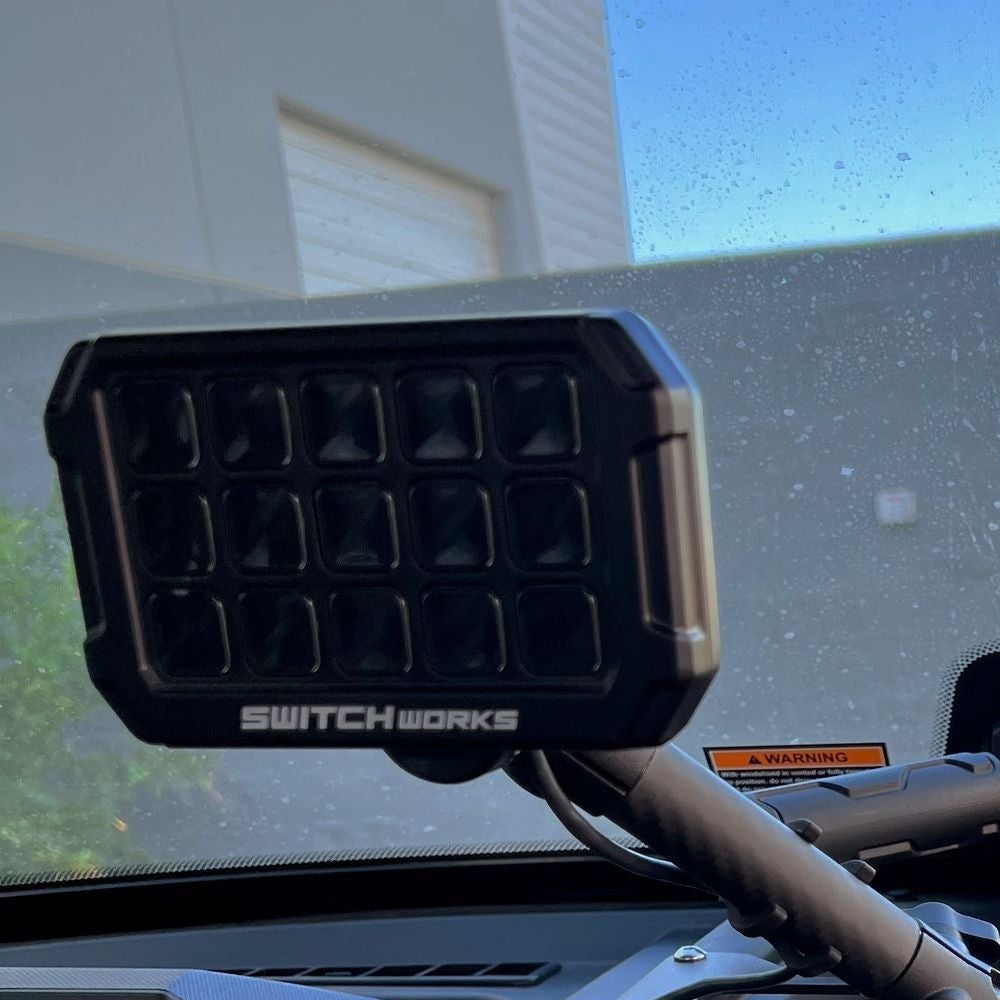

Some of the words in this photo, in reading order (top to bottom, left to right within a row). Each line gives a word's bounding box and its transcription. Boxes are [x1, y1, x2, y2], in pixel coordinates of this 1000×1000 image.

[240, 705, 395, 730] SWITCH
[397, 710, 519, 730] WORKS
[764, 752, 848, 765] WARNING
